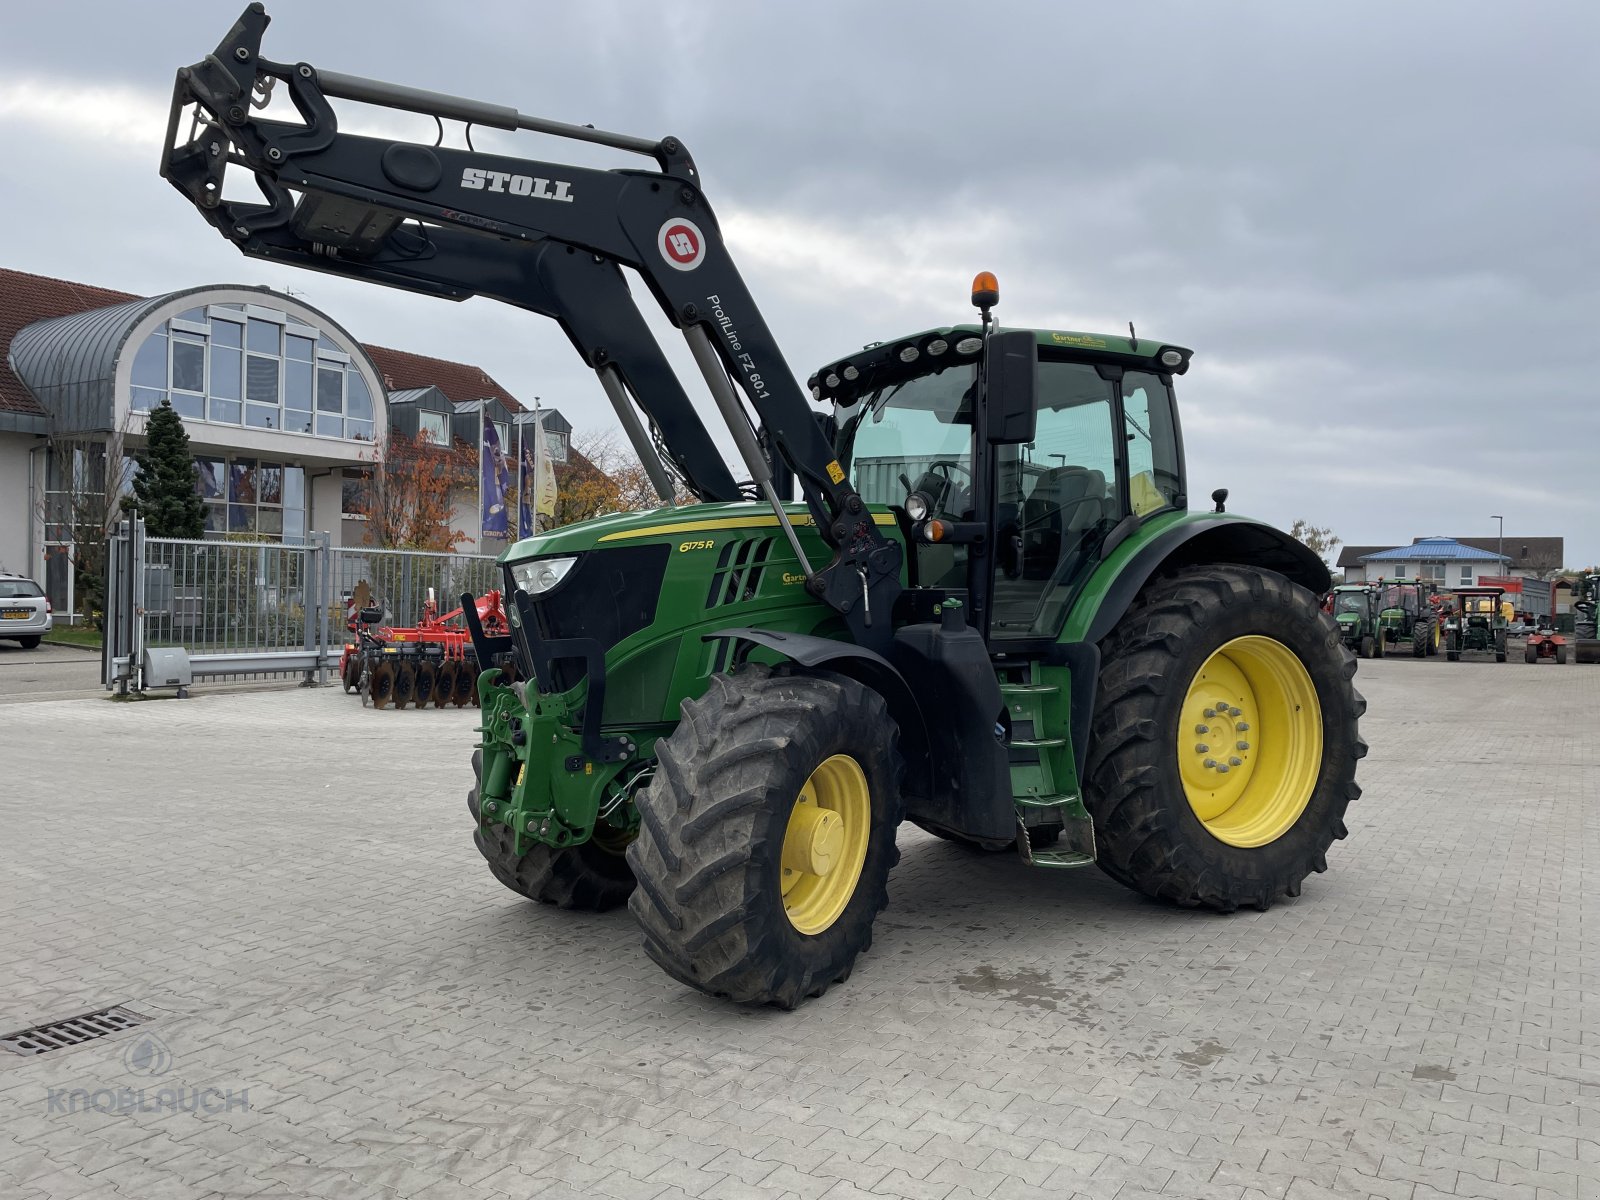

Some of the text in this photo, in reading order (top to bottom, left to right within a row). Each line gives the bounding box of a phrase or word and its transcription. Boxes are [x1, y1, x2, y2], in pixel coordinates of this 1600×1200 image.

[460, 167, 574, 202] STOLL
[706, 294, 772, 399] ProfiLine FZ 60.1
